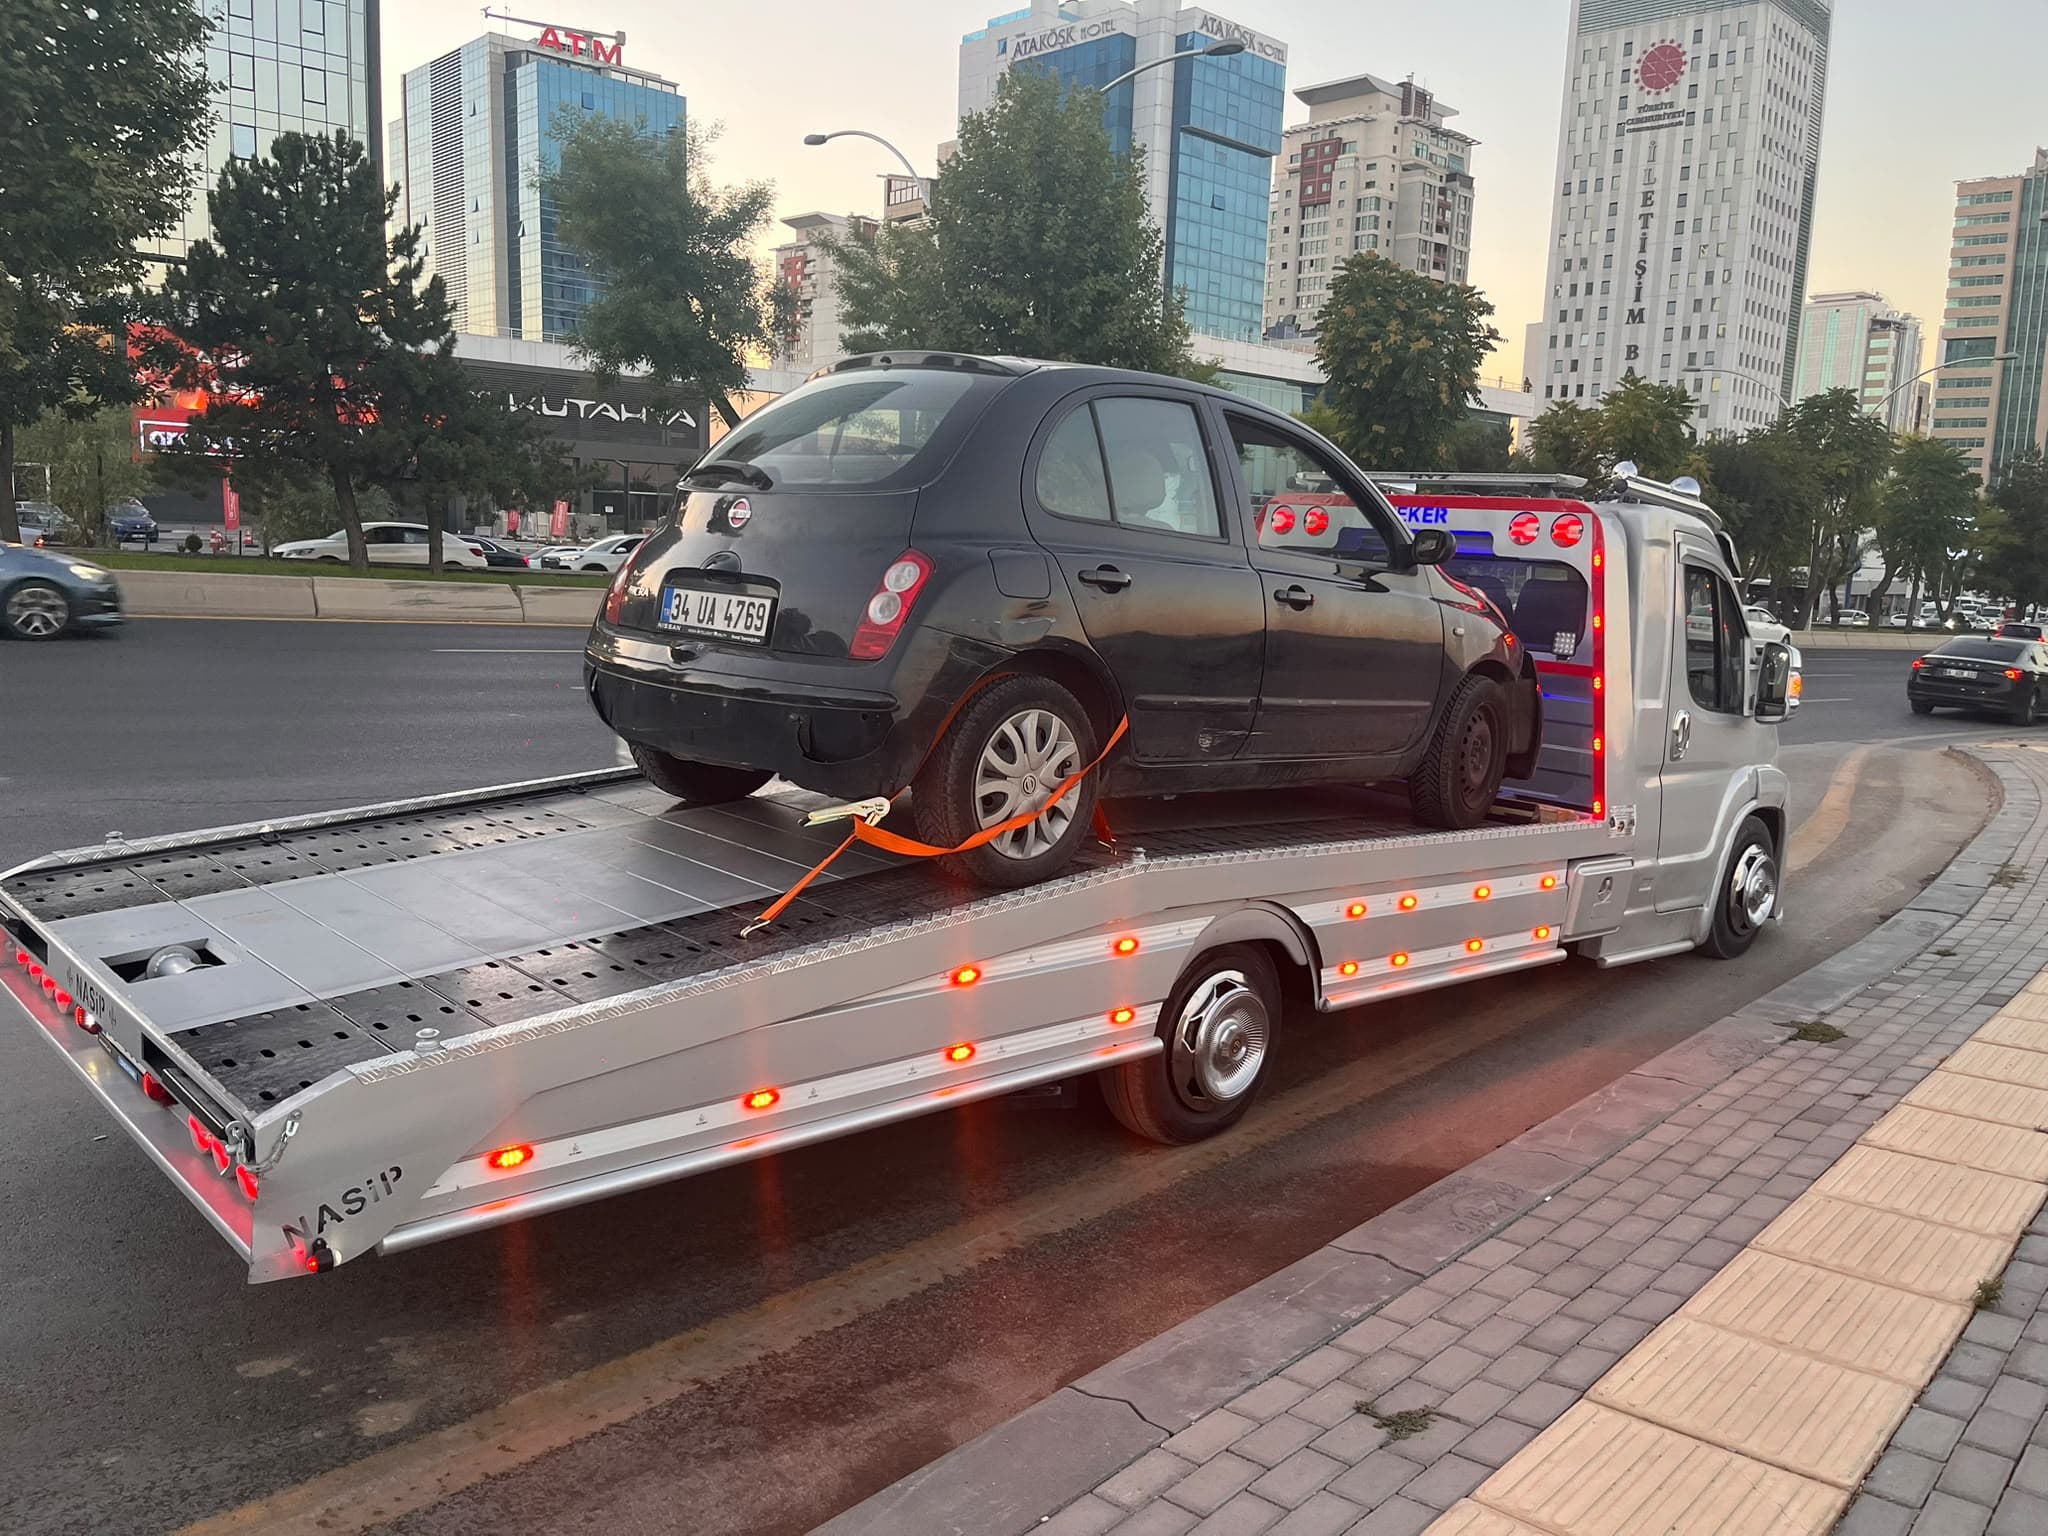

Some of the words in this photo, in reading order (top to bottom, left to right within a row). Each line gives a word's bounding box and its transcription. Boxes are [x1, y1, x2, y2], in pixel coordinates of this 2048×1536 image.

[538, 26, 623, 67] ATM
[1012, 26, 1076, 60] ATAKÖŞK
[1080, 19, 1116, 40] HOTEL
[671, 593, 690, 622] 34
[697, 595, 717, 625] UA
[723, 599, 767, 632] 4769
